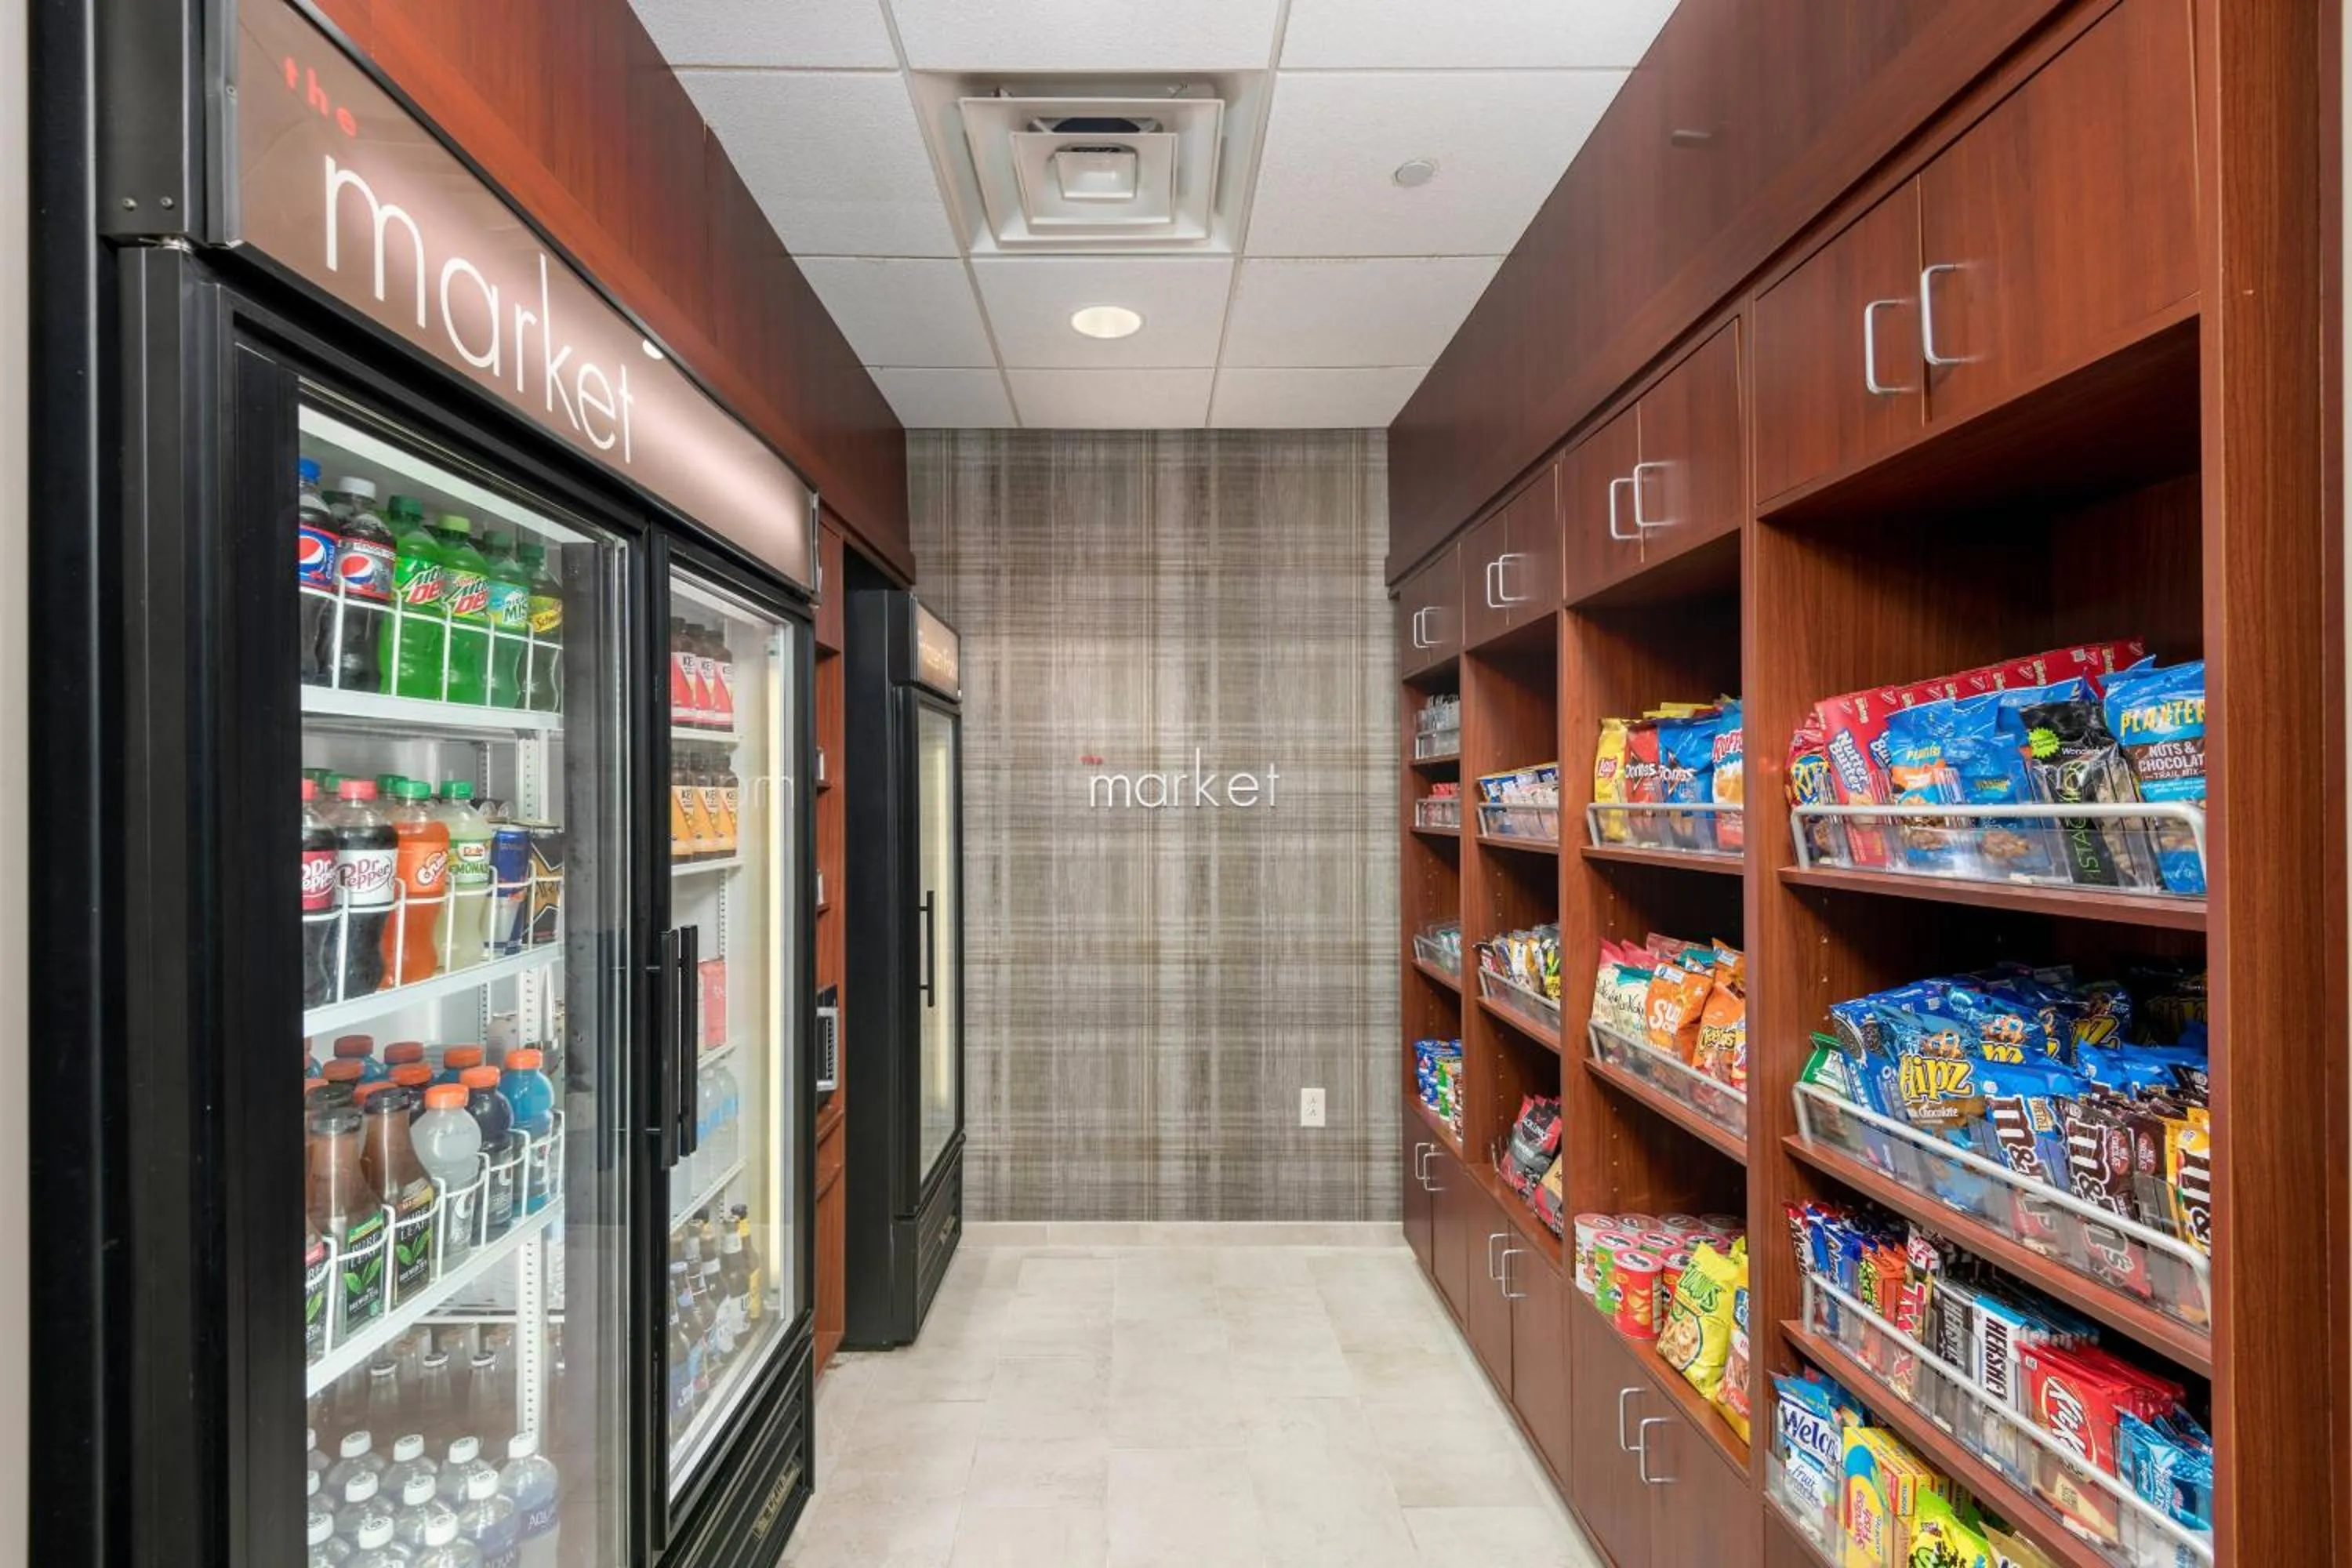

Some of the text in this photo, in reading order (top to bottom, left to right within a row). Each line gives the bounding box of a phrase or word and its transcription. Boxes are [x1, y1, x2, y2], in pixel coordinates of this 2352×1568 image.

[284, 56, 358, 137] the
[325, 154, 635, 464] market
[2149, 740, 2196, 758] NUTS &
[1090, 746, 1280, 808] market
[336, 862, 390, 890] Pepper
[357, 858, 379, 875] Dr
